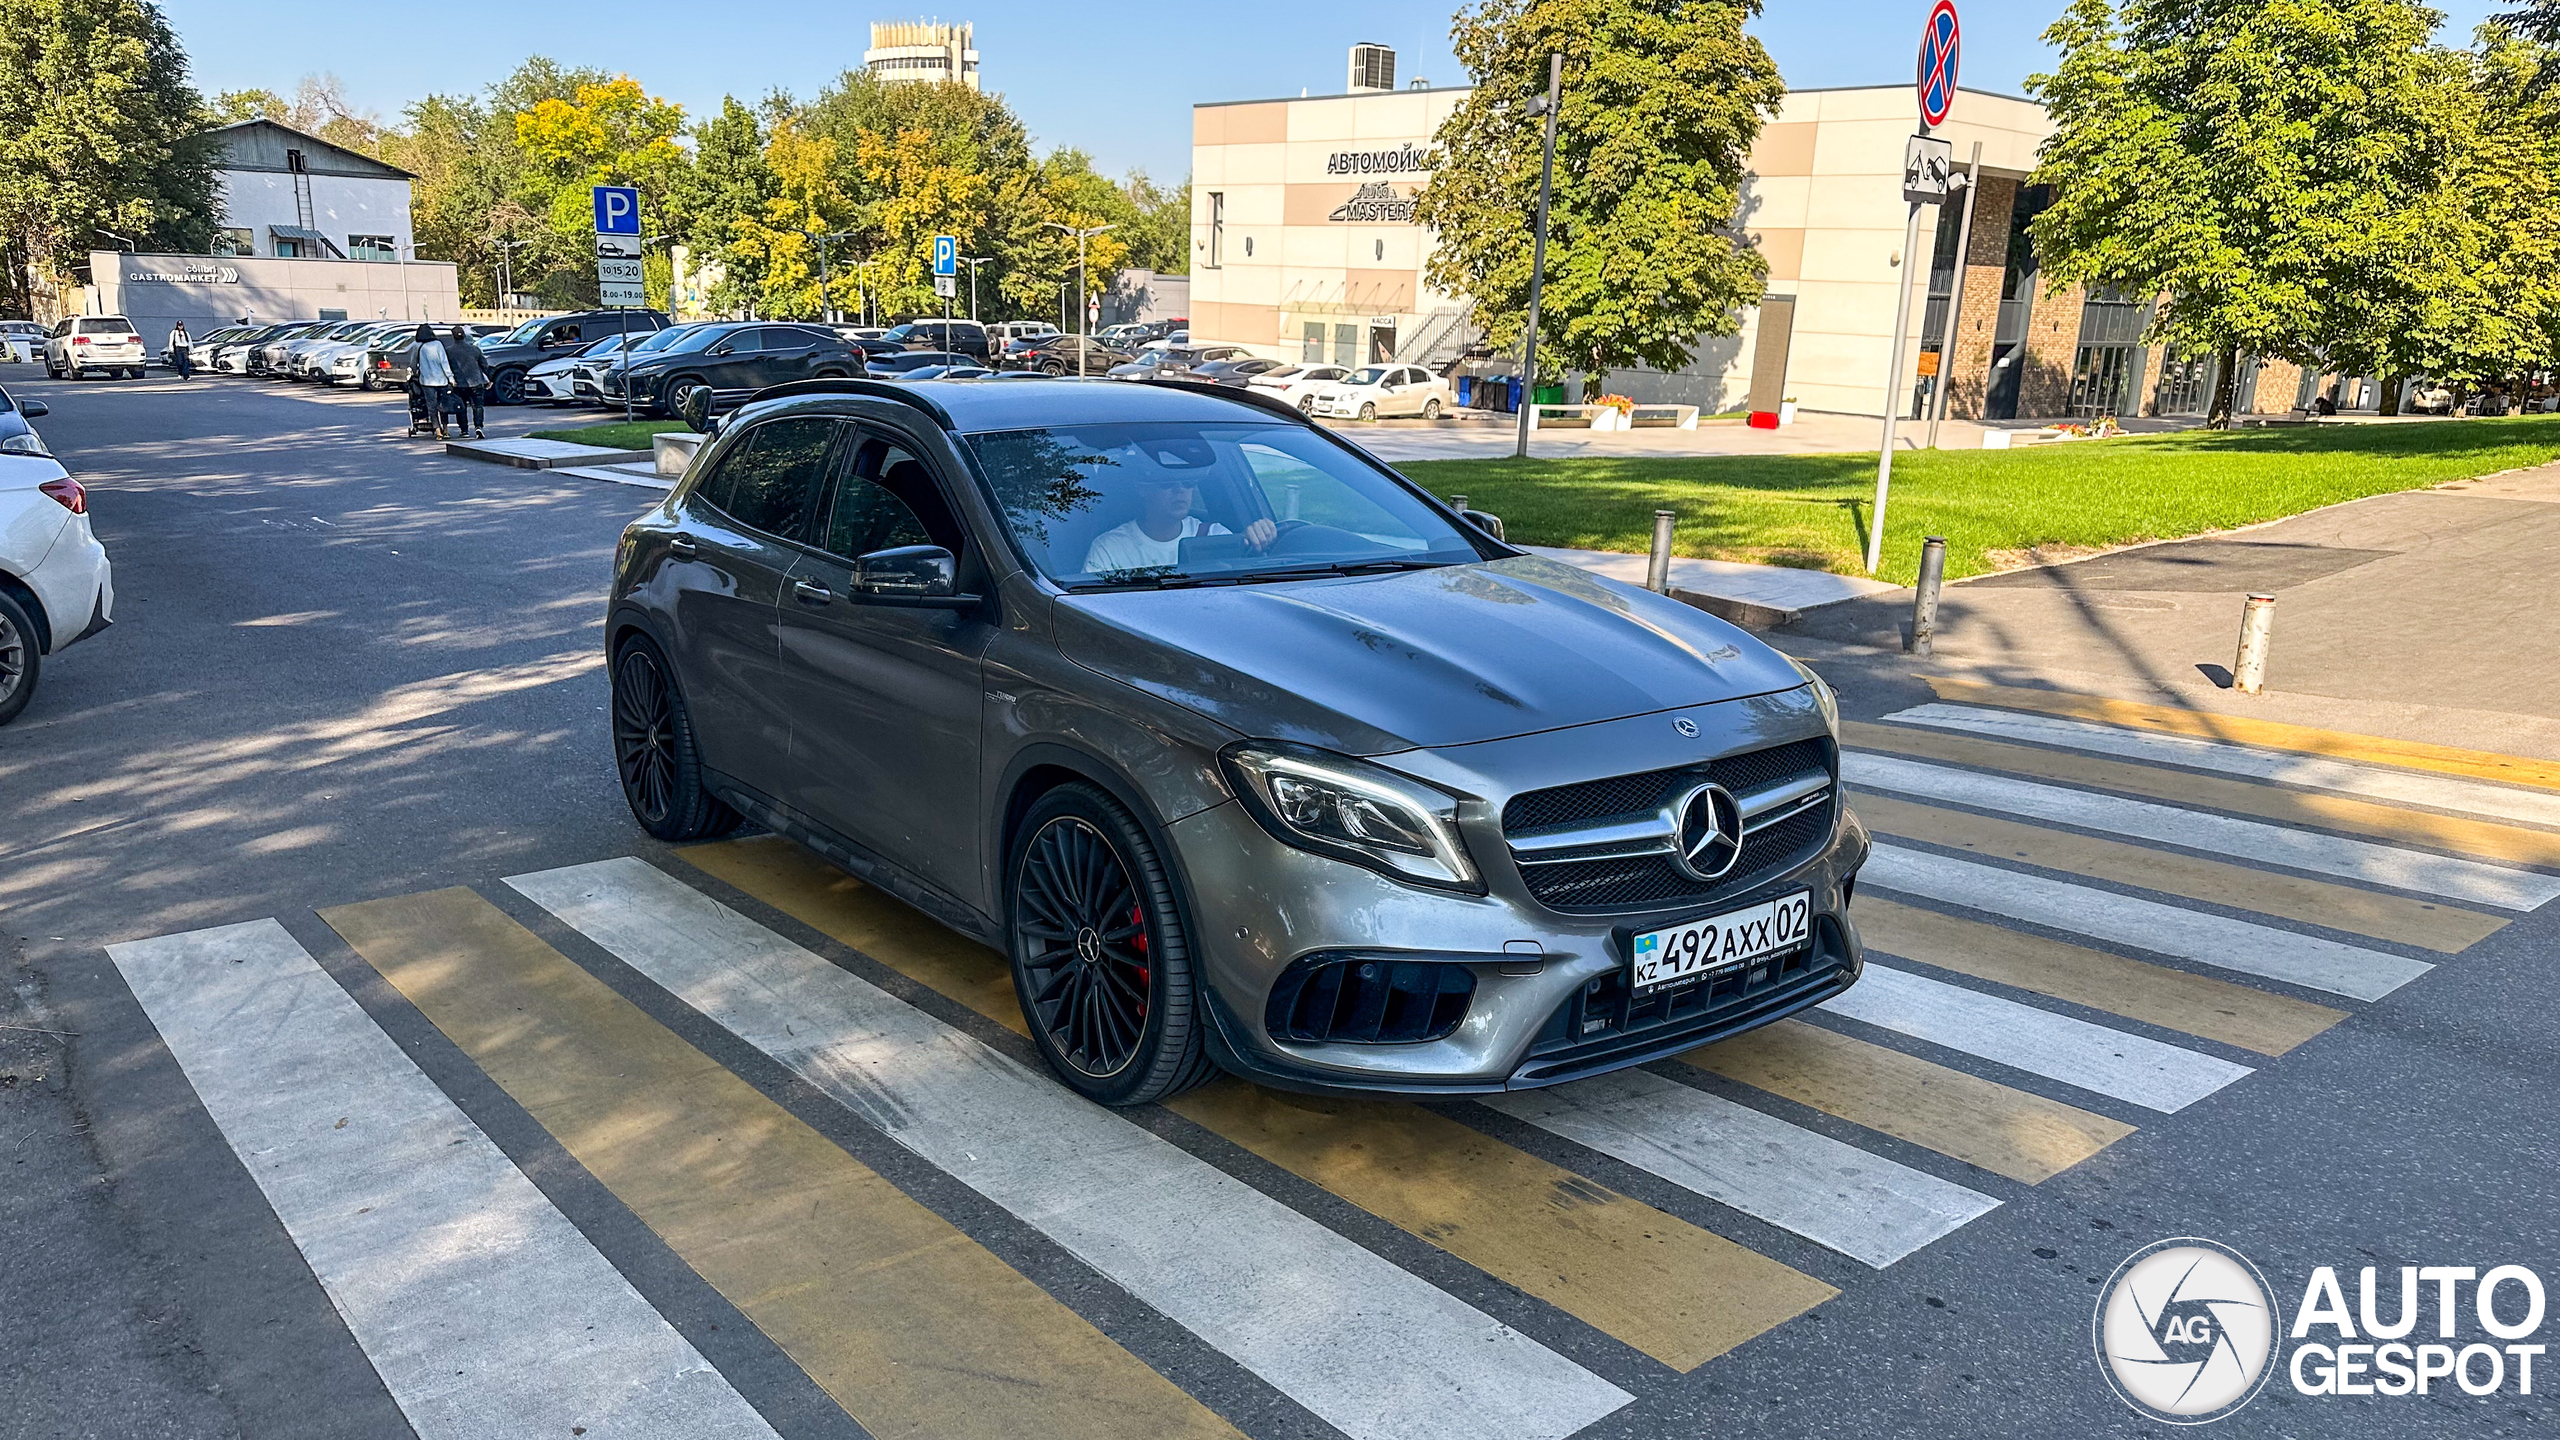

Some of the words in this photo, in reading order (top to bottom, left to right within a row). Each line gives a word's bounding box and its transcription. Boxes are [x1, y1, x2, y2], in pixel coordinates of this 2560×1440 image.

[1327, 142, 1437, 173] АВТОМОЙК
[606, 191, 630, 229] P
[939, 240, 951, 271] P
[130, 272, 218, 283] GASTROMARKET
[602, 266, 611, 275] 10
[613, 266, 623, 275] 15
[625, 265, 639, 276] 20
[1371, 317, 1392, 325] КАССА
[1636, 961, 1658, 983] KZ
